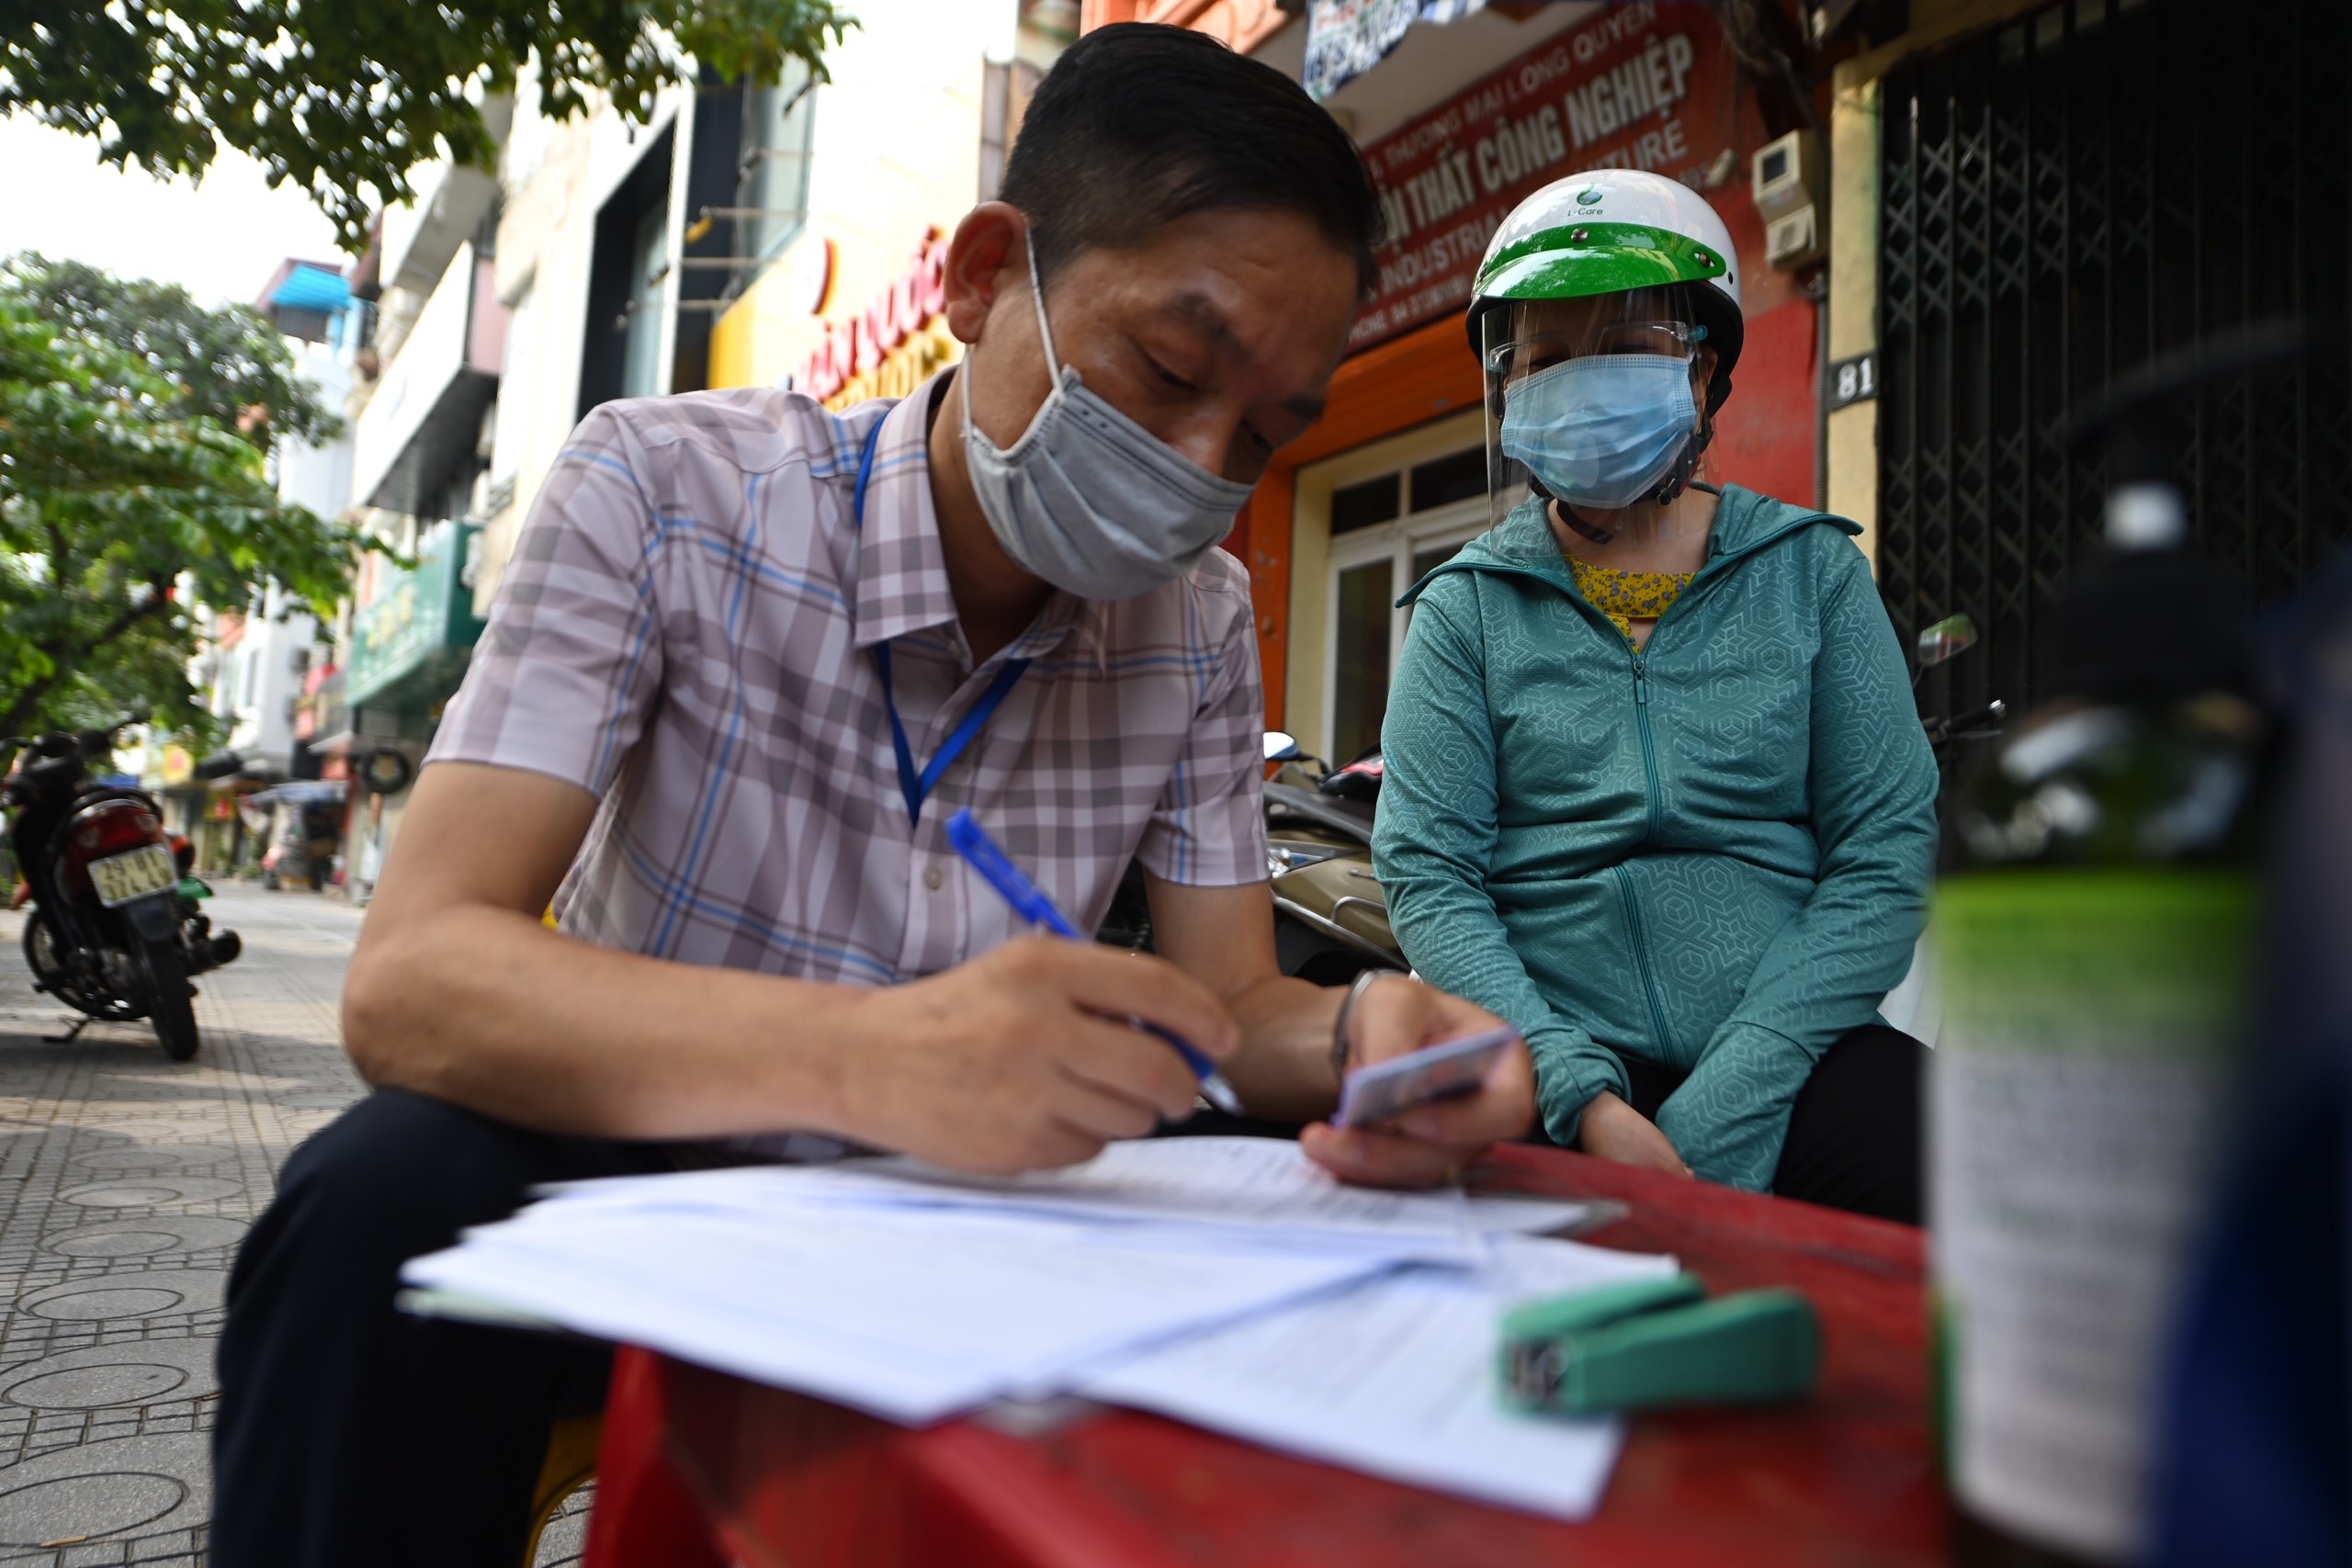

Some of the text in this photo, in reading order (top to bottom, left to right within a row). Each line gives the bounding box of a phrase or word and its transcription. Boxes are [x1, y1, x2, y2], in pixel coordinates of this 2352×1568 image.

[1504, 45, 1571, 103] LONG
[1404, 140, 1476, 229] THẤT
[1475, 103, 1567, 193] CÔNG
[1565, 31, 1694, 150] NGHIỆP
[1838, 357, 1874, 401] 81
